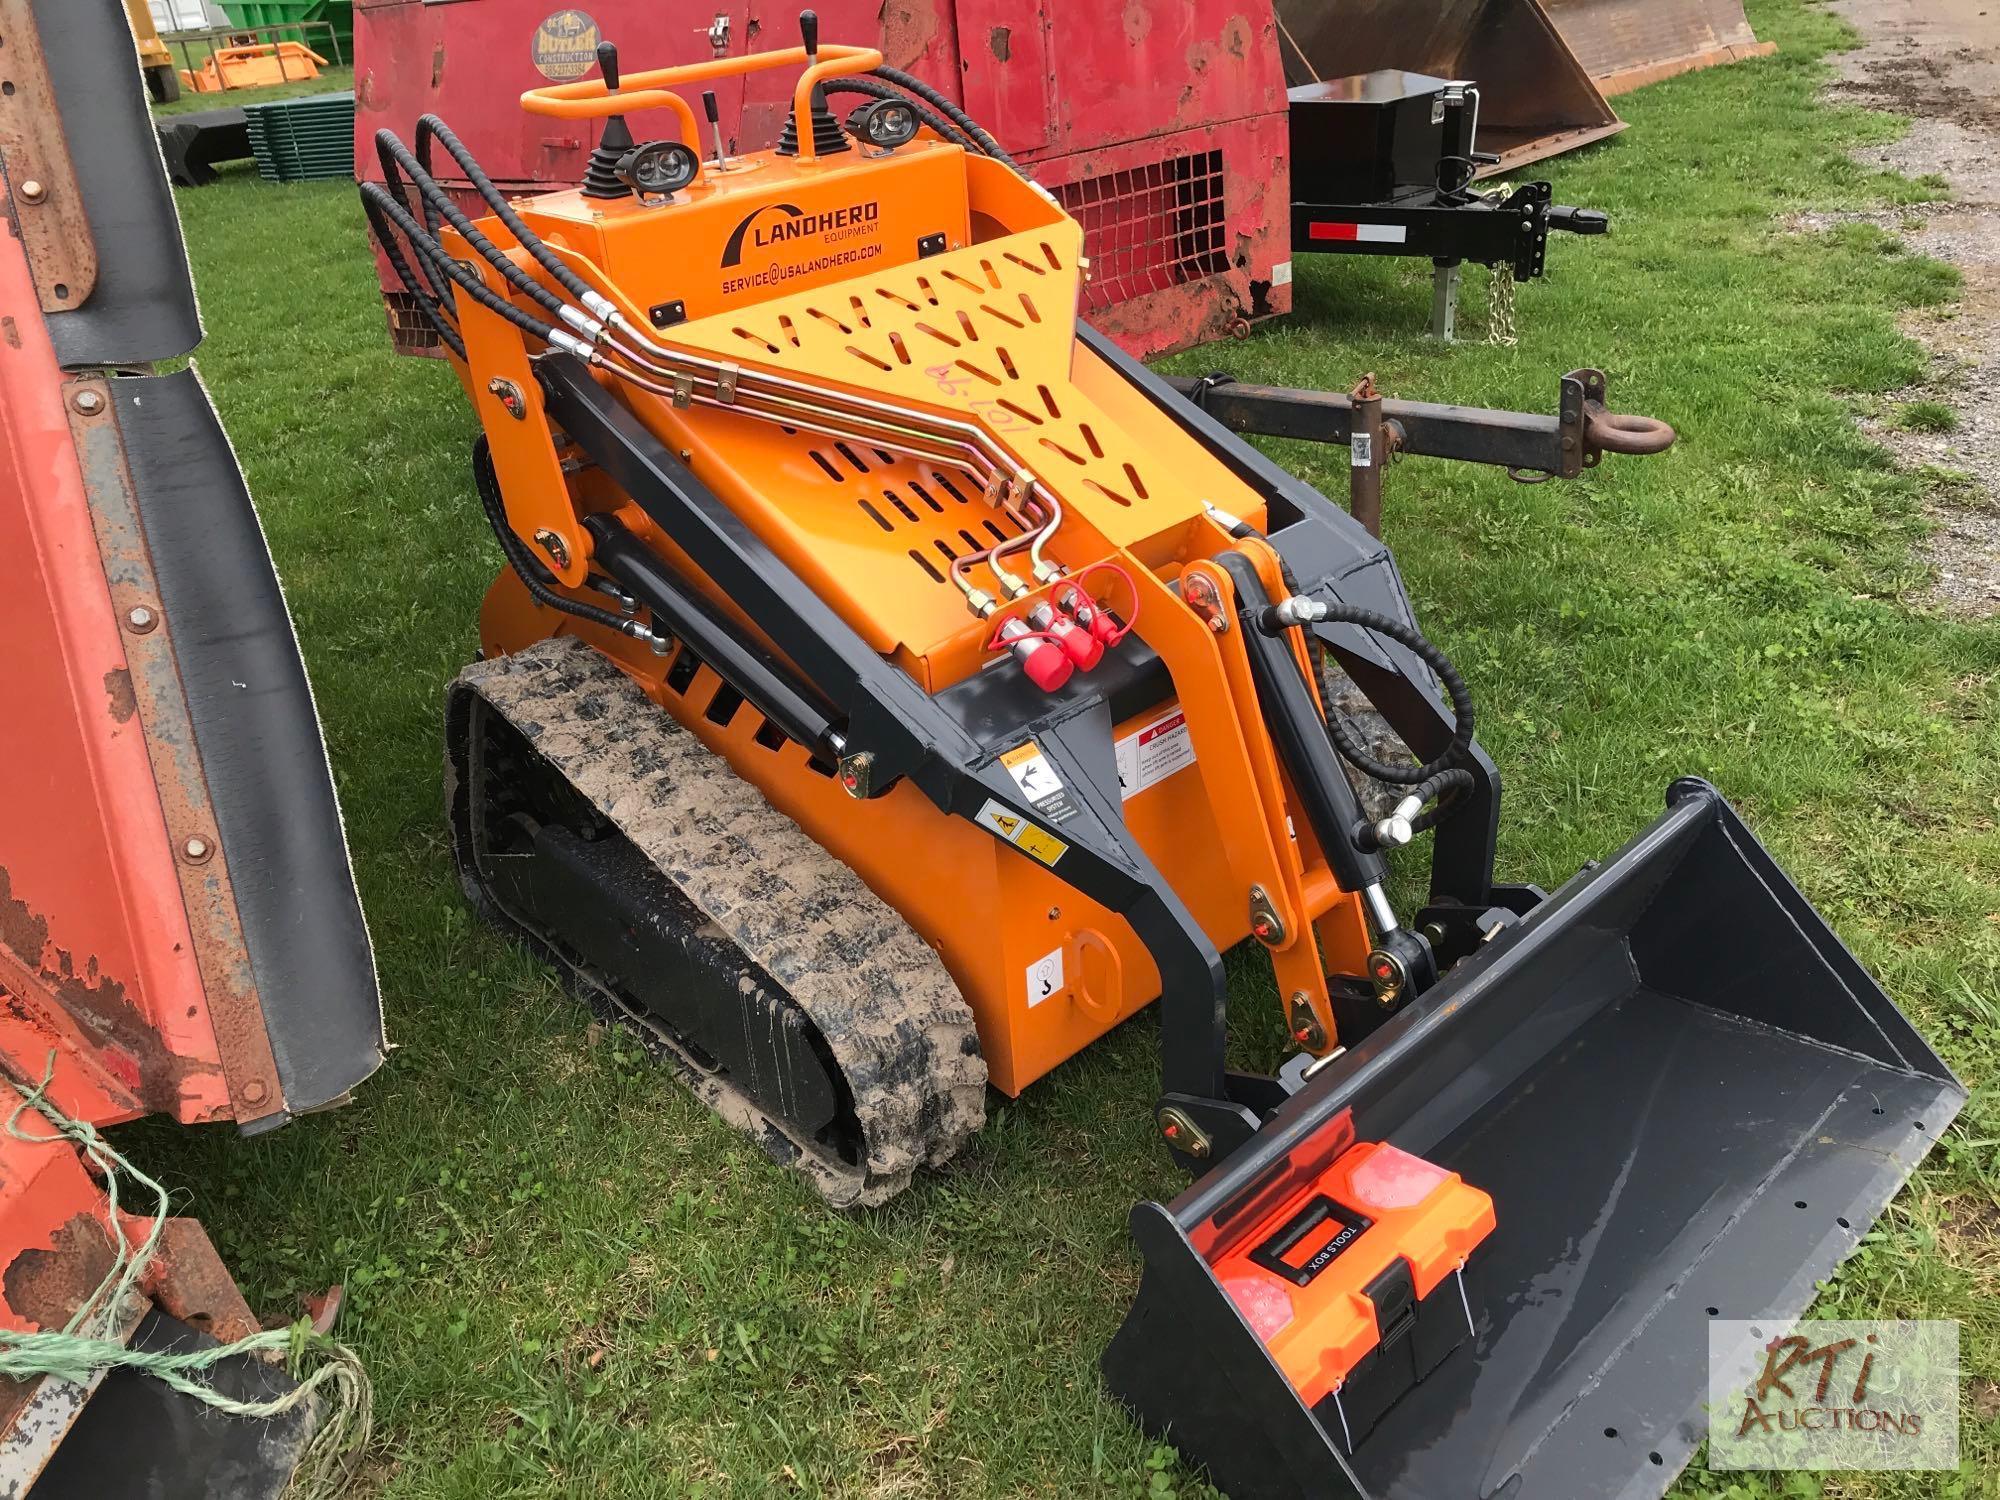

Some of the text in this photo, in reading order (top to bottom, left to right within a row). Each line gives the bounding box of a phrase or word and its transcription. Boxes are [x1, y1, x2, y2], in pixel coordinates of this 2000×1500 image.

[538, 25, 597, 54] BUTLER
[539, 52, 593, 64] CONSTRUCTION
[755, 202, 878, 247] LANDHERO
[824, 222, 880, 244] EQUIPMENT
[722, 244, 882, 294] SERVICE@USALANDHERO.COM
[1308, 1227, 1357, 1270] TOOLS BOX
